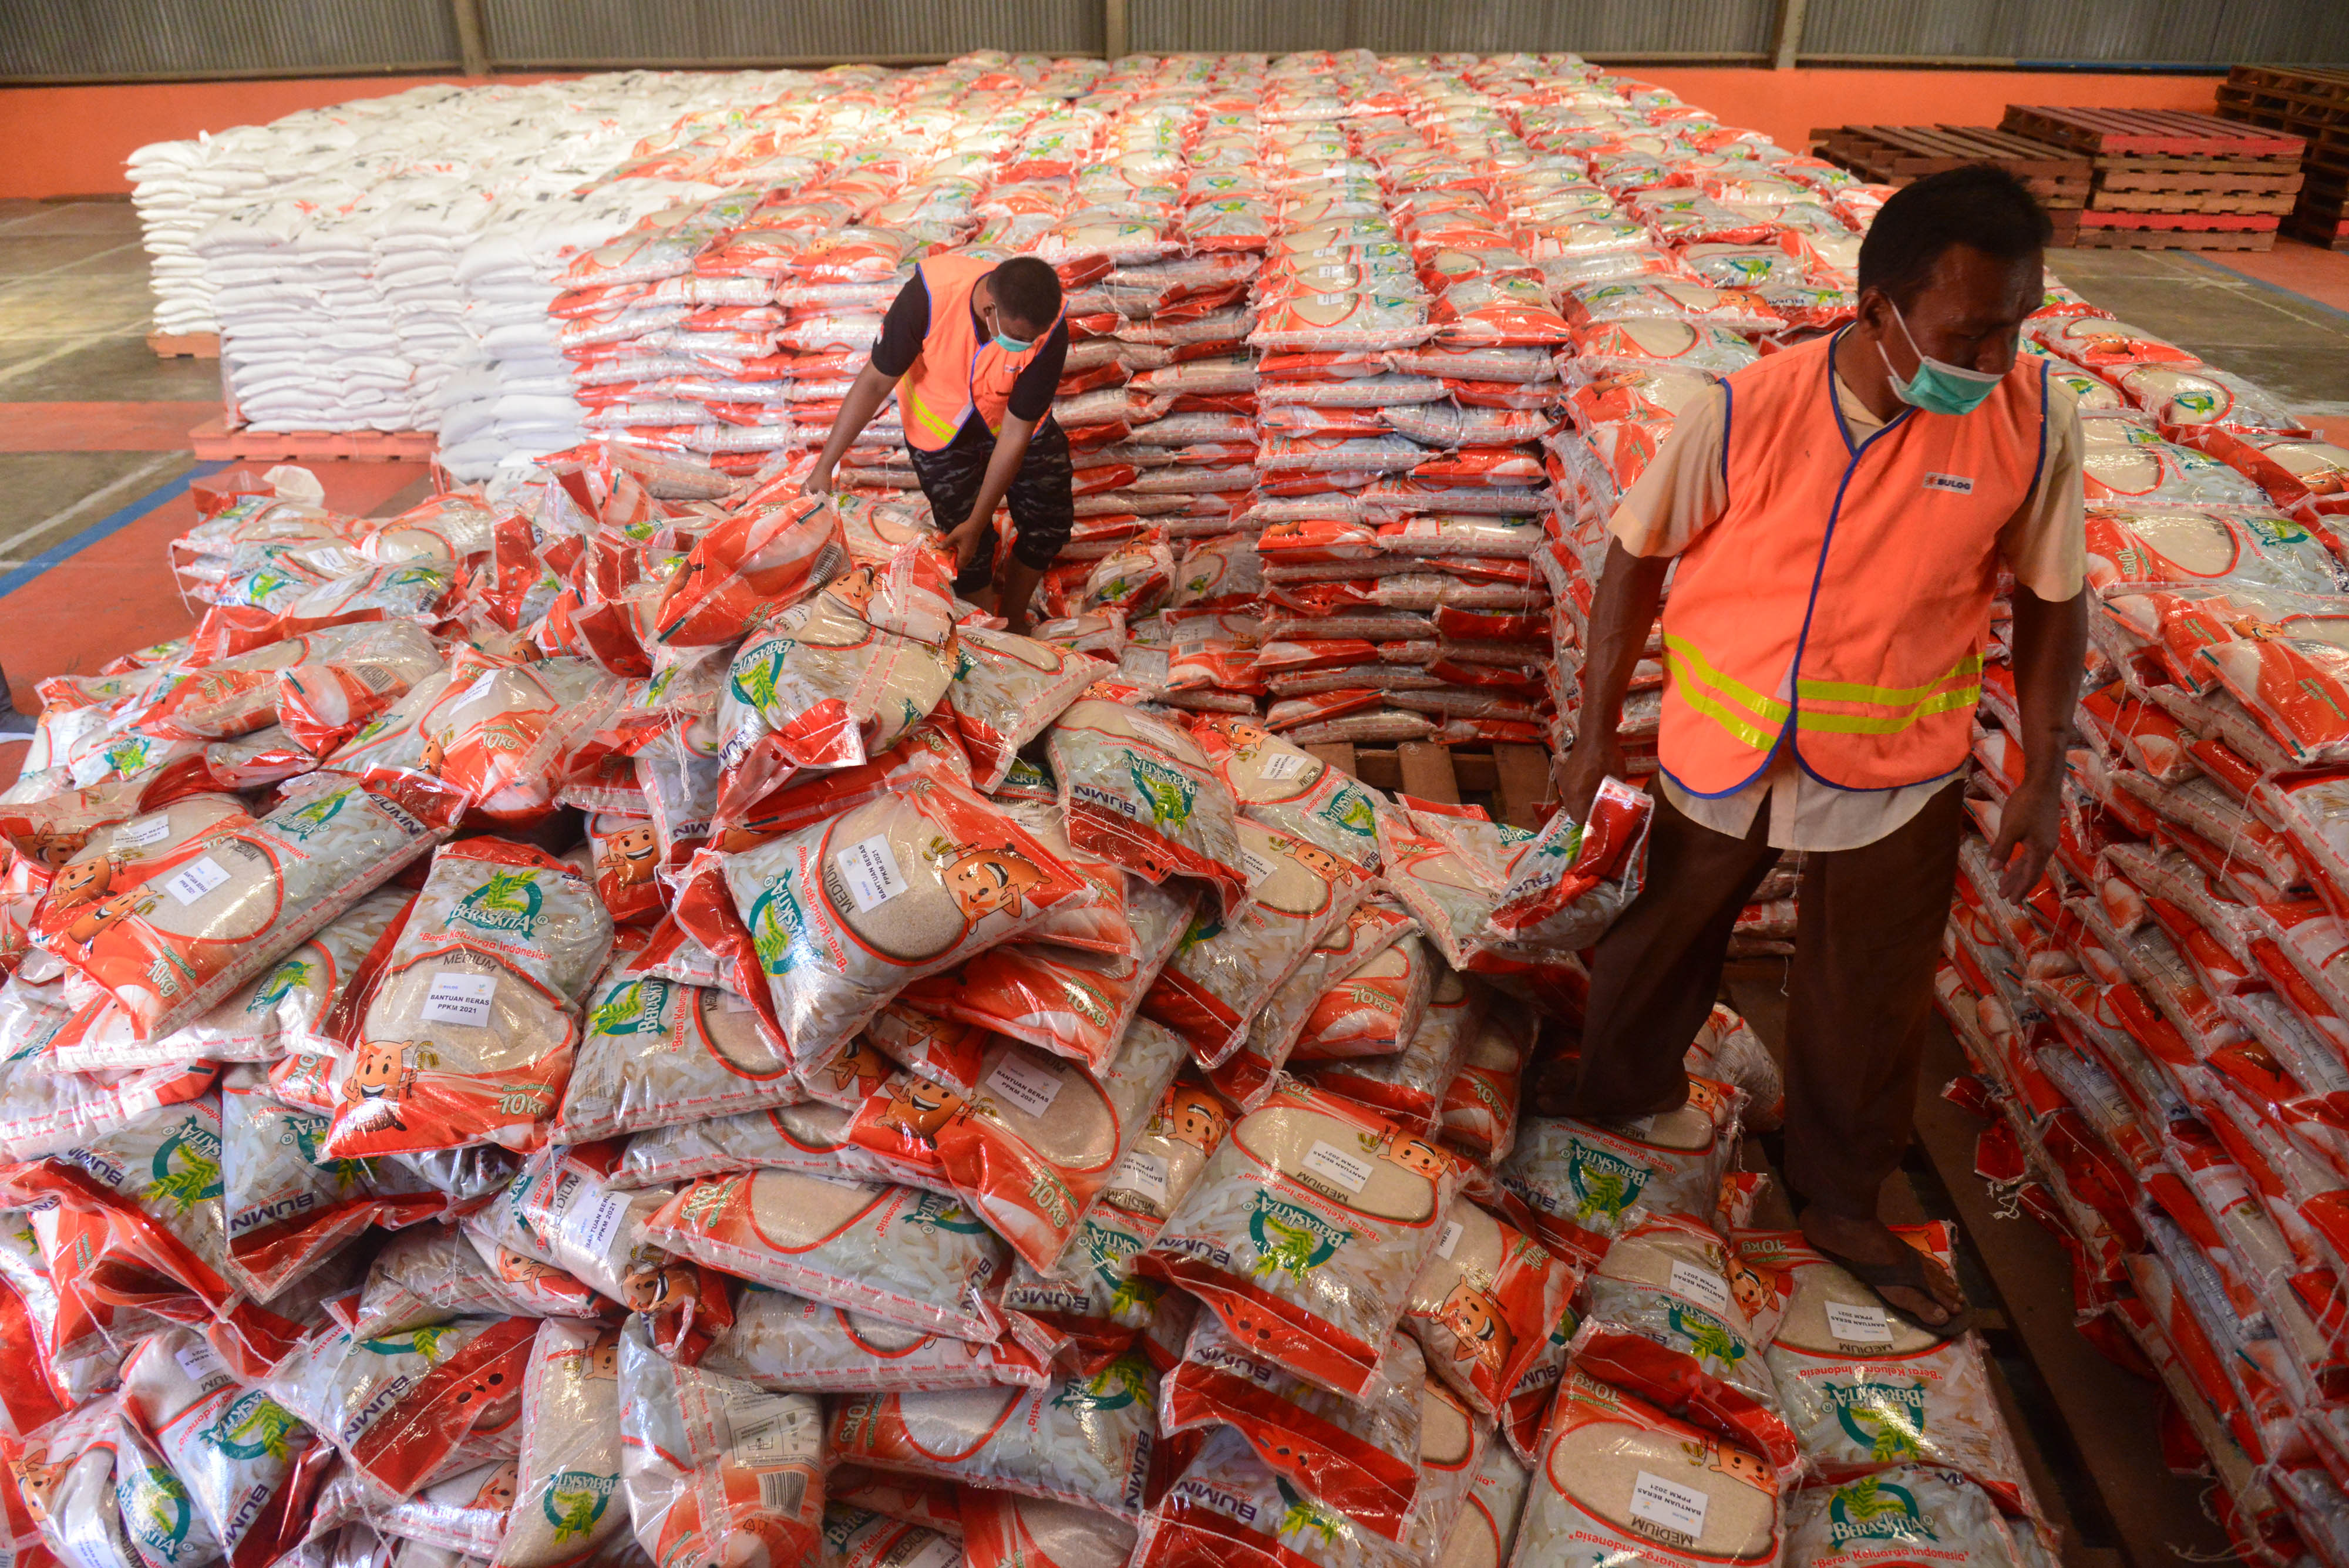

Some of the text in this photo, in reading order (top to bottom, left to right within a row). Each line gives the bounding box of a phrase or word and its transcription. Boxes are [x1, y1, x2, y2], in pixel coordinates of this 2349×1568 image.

[1938, 479, 1971, 490] BULOG
[369, 793, 420, 835] BUMN
[1075, 785, 1136, 815] BUMN
[859, 844, 886, 899] BANTUAN BERAS
[872, 850, 891, 884] PPKM 2021
[443, 953, 497, 972] MEDIUM
[497, 942, 551, 961] Indonesia"
[827, 936, 848, 973] "Beras
[146, 957, 178, 998] 10kg
[438, 1003, 477, 1014] PPKM 2021
[465, 997, 490, 1005] BERAS
[1350, 988, 1393, 1014] 10kg
[671, 1021, 684, 1052] "Beras
[997, 1070, 1049, 1103] BANTUAN BERAS
[1001, 1082, 1036, 1104] PPKM 2021
[1313, 1150, 1366, 1181] BANTUAN BERAS
[1325, 1151, 1359, 1170] PPKM 2021
[1297, 1172, 1348, 1202] MEDIUM
[230, 1193, 314, 1231] BUMN
[1028, 1177, 1069, 1229] 10kg
[597, 1203, 617, 1242] PPKM 2021
[1347, 1219, 1381, 1243] "Beras
[1156, 1237, 1231, 1265] BUMN
[1742, 1240, 1786, 1253] 10kg
[1009, 1289, 1091, 1311] BUMN
[1674, 1274, 1725, 1301] BANTUAN BERAS
[1830, 1315, 1852, 1324] BERAS
[1839, 1342, 1893, 1354] MEDIUM
[1573, 1374, 1622, 1403] 10kg
[1909, 1369, 1943, 1381] "Beras
[344, 1375, 410, 1443] BUMN
[1125, 1429, 1150, 1509] BUMN
[1176, 1480, 1257, 1522] BUMN
[1637, 1488, 1701, 1516] BANTUAN BERAS
[1650, 1485, 1691, 1503] PPKM 2021
[1632, 1516, 1693, 1546] MEDIUM
[1812, 1547, 1969, 1568] "Beras Keluarga Indonesia"
